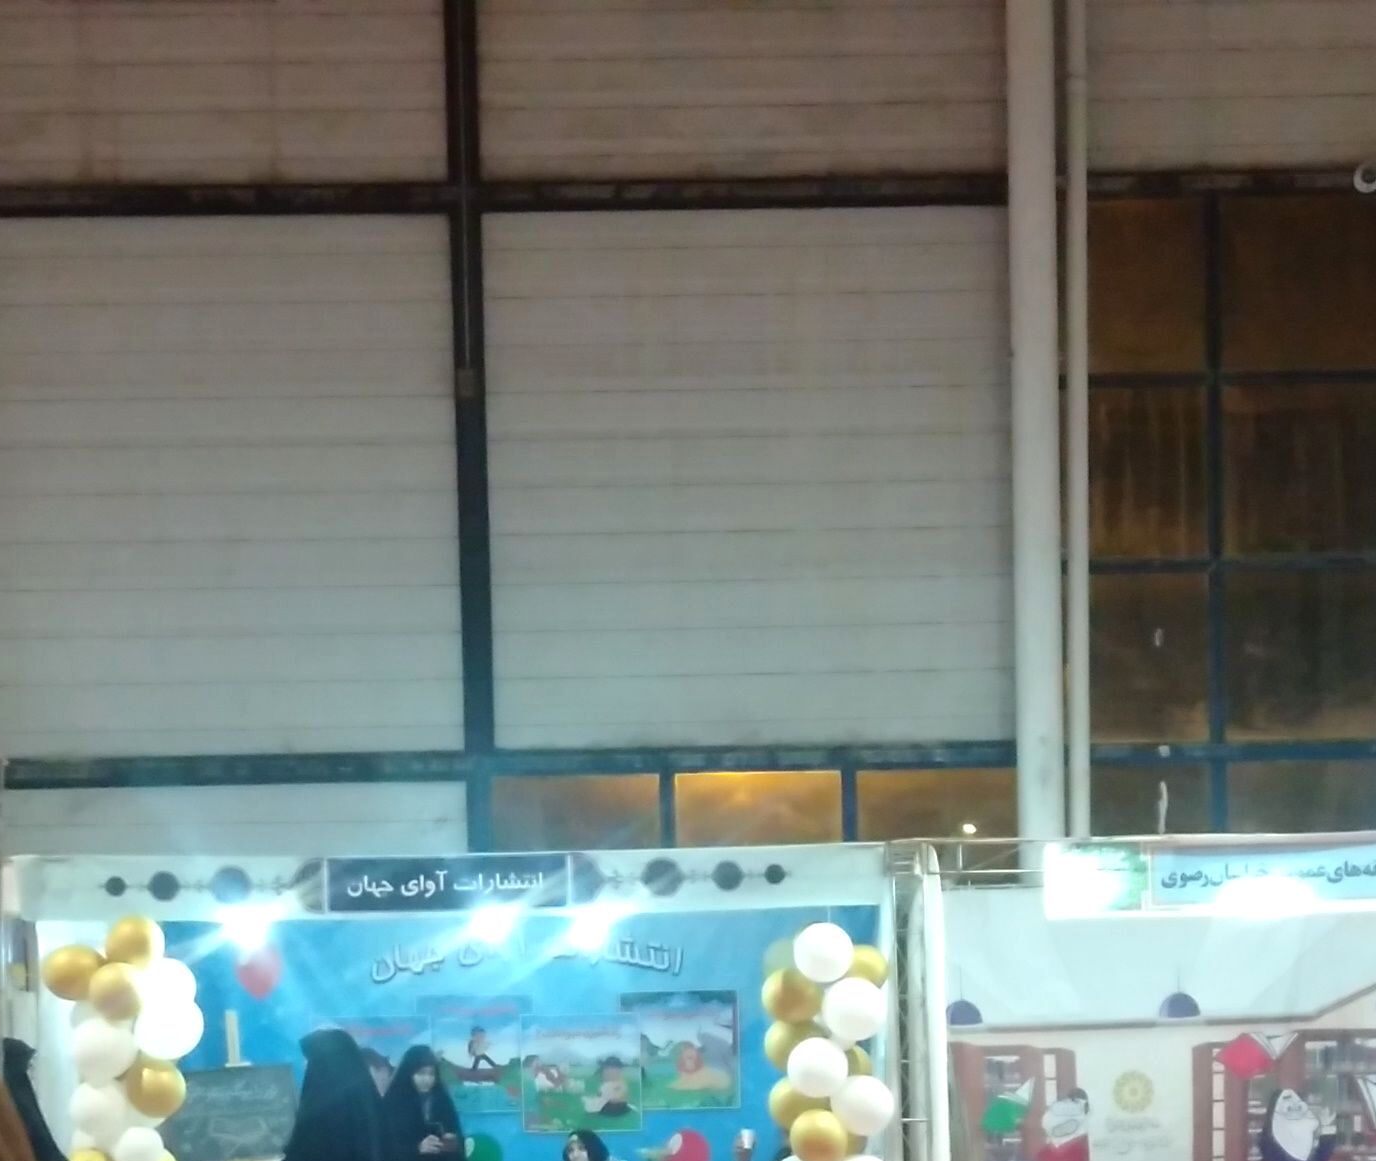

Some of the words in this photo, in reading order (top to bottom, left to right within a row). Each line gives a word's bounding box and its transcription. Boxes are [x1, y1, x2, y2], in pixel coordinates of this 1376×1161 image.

[347, 874, 395, 899] جهان
[400, 869, 449, 898] آوای
[452, 871, 544, 894] انتشارات
